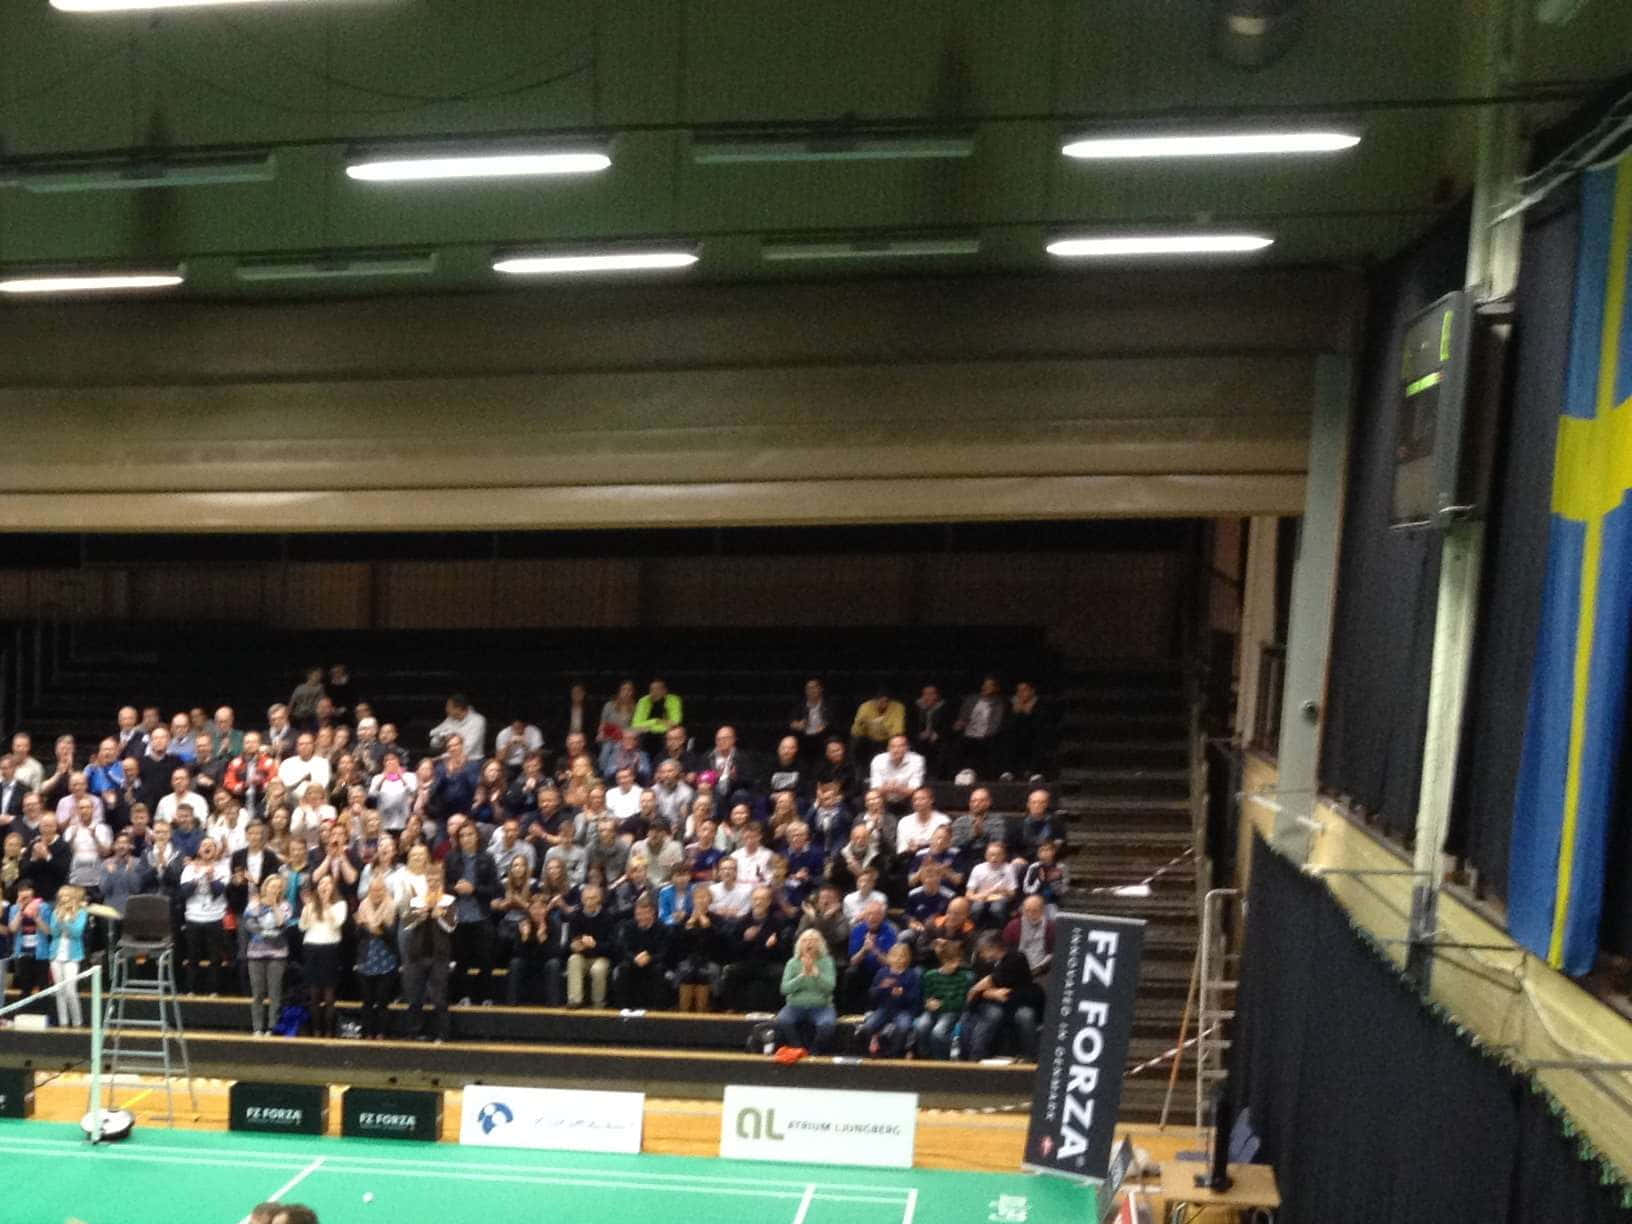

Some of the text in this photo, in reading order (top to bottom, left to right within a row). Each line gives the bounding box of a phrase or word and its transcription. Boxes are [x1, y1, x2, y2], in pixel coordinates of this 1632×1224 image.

[1055, 929, 1120, 1160] FZ FORZA
[245, 1106, 302, 1120] FZ FORZA
[359, 1112, 375, 1124] FZ
[376, 1113, 416, 1126] FORZA
